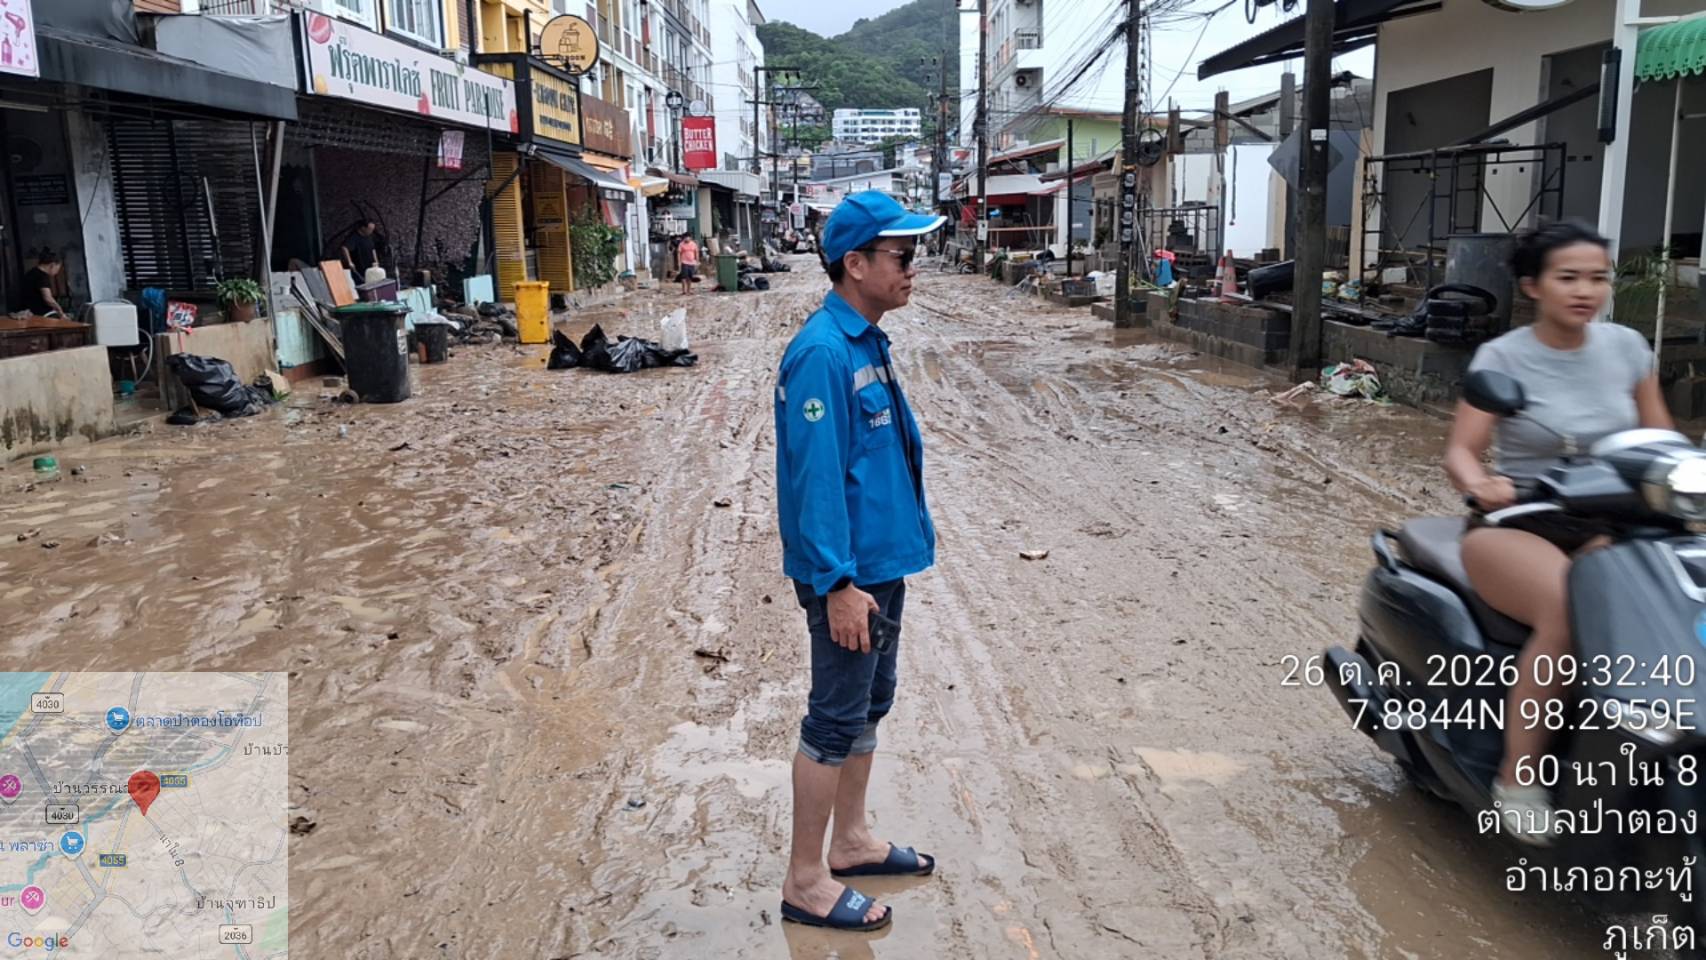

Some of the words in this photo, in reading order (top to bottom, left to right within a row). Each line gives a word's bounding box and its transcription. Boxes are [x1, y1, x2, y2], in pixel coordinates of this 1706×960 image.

[430, 68, 460, 111] FRUIT
[463, 79, 505, 120] PARADISE
[684, 127, 712, 140] BUTTER
[684, 139, 714, 152] CHICKEN
